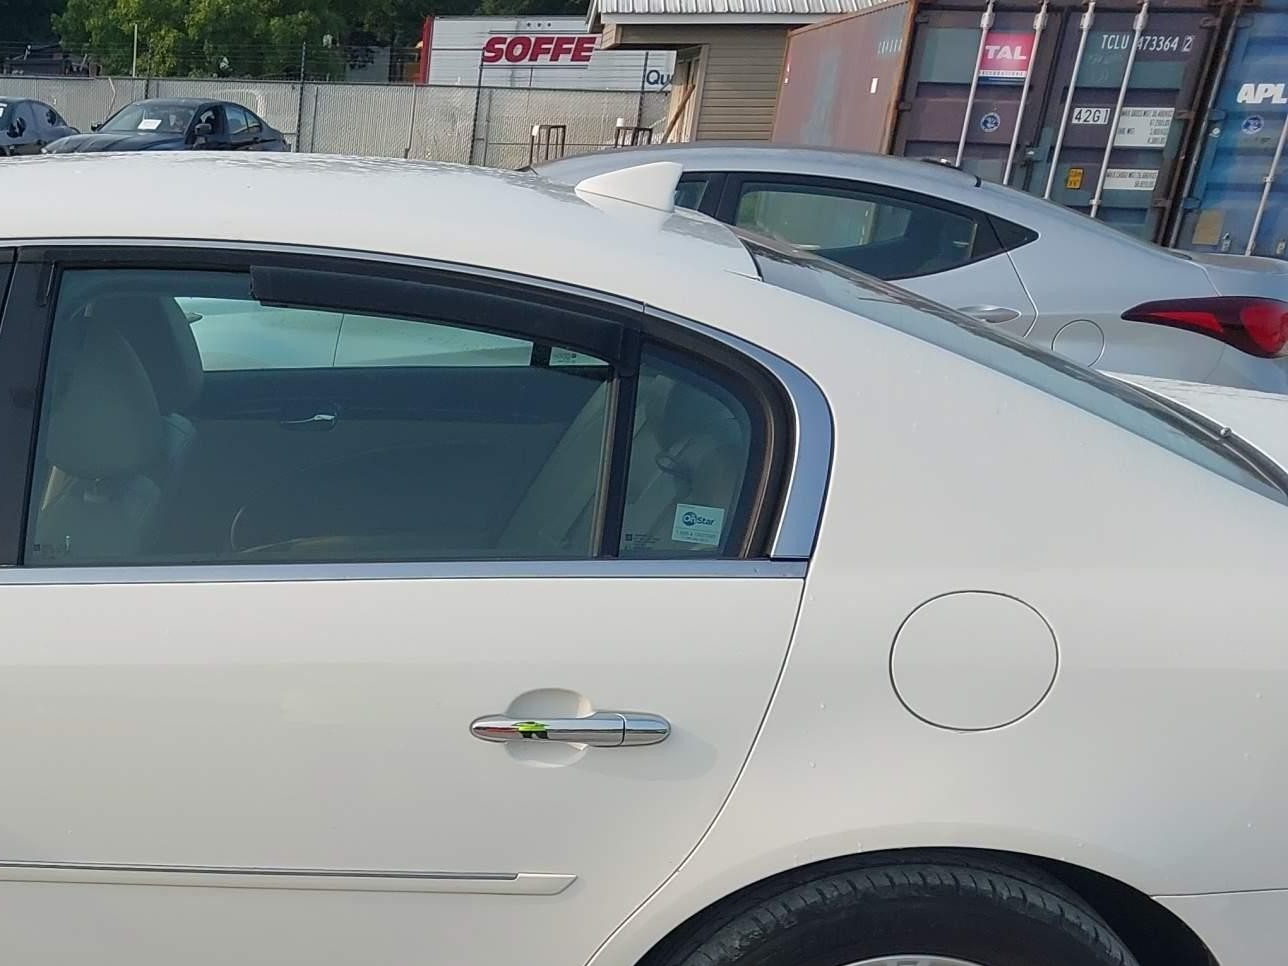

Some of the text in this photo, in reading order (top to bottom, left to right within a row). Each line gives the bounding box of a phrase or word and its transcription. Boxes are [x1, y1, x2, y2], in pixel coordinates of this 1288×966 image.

[483, 36, 597, 63] SOFFE
[1100, 34, 1193, 52] TCLU 473364 2
[985, 45, 1027, 60] TAL
[1237, 83, 1288, 104] APL
[1074, 109, 1109, 123] 42G1
